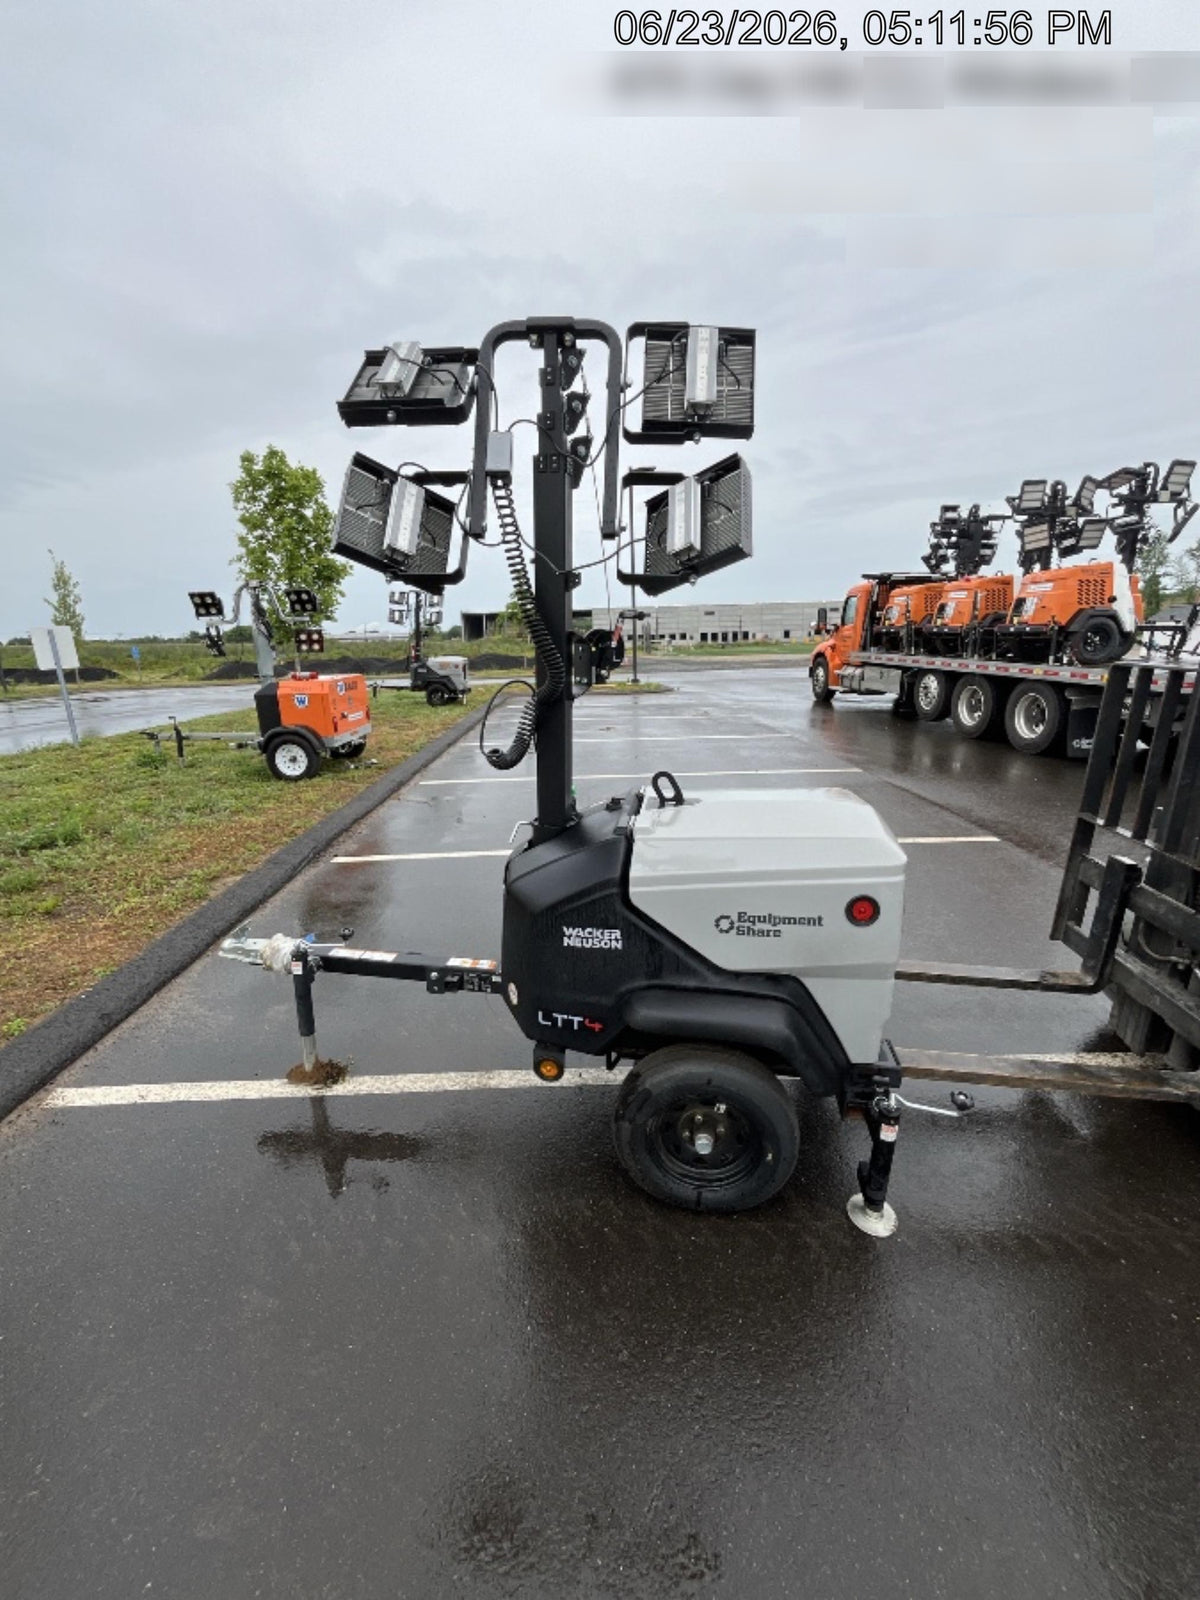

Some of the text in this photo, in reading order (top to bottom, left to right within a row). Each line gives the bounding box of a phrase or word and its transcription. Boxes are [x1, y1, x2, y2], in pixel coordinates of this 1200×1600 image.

[737, 911, 824, 927] Equipment
[562, 926, 622, 939] WACKER
[735, 924, 782, 938] Share
[563, 936, 623, 950] NEUSON
[537, 1010, 603, 1032] LTT4
